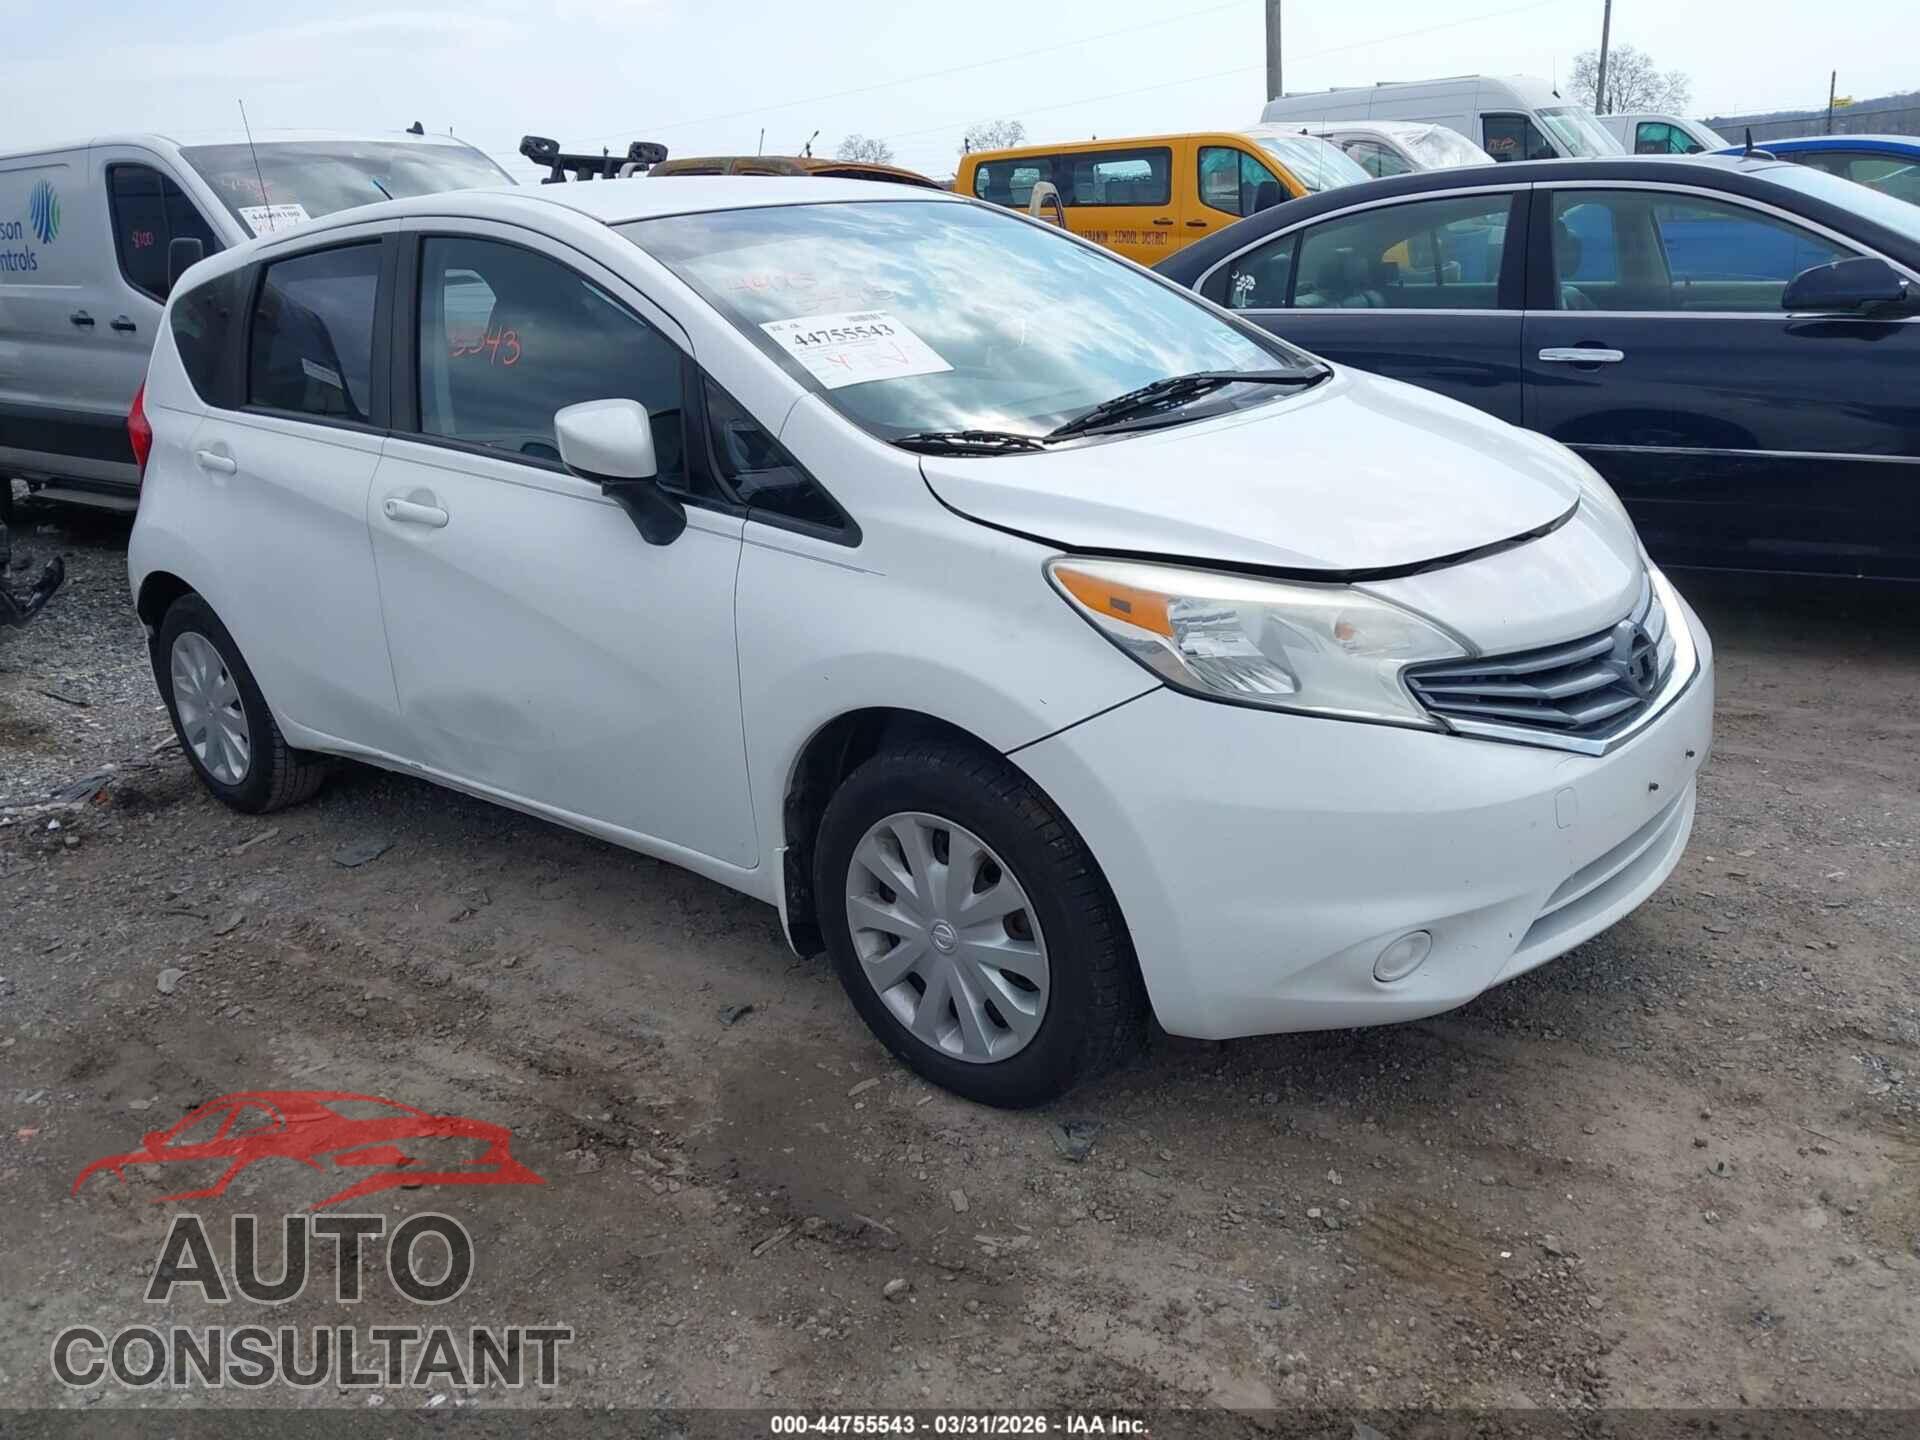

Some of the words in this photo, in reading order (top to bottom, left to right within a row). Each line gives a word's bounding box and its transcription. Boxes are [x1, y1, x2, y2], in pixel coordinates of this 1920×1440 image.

[0, 222, 22, 240] son
[1114, 230, 1137, 244] SCHOOL
[1142, 231, 1168, 245] DISTRICT
[0, 245, 37, 271] ntrols
[795, 324, 894, 346] 44755543
